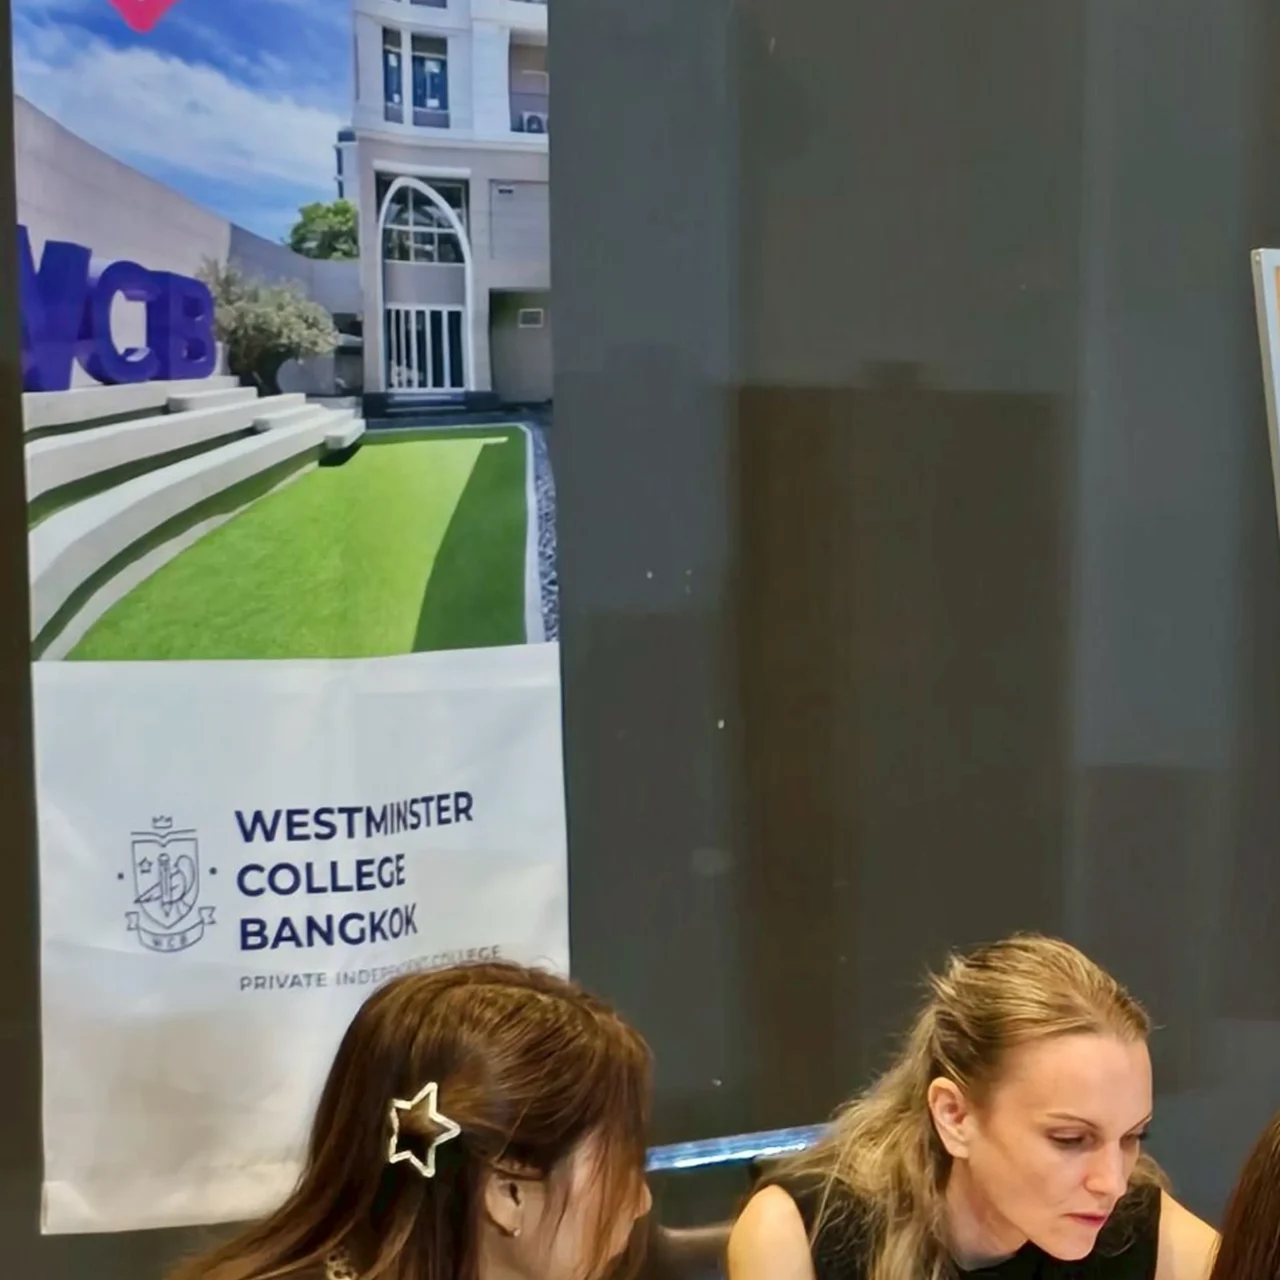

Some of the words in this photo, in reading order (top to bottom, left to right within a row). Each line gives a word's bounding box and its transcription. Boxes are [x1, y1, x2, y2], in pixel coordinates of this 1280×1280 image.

[235, 791, 474, 843] WESTMINSTER
[237, 853, 406, 897] COLLEGE
[239, 903, 418, 951] BANGKOK
[240, 972, 328, 991] PRIVATE
